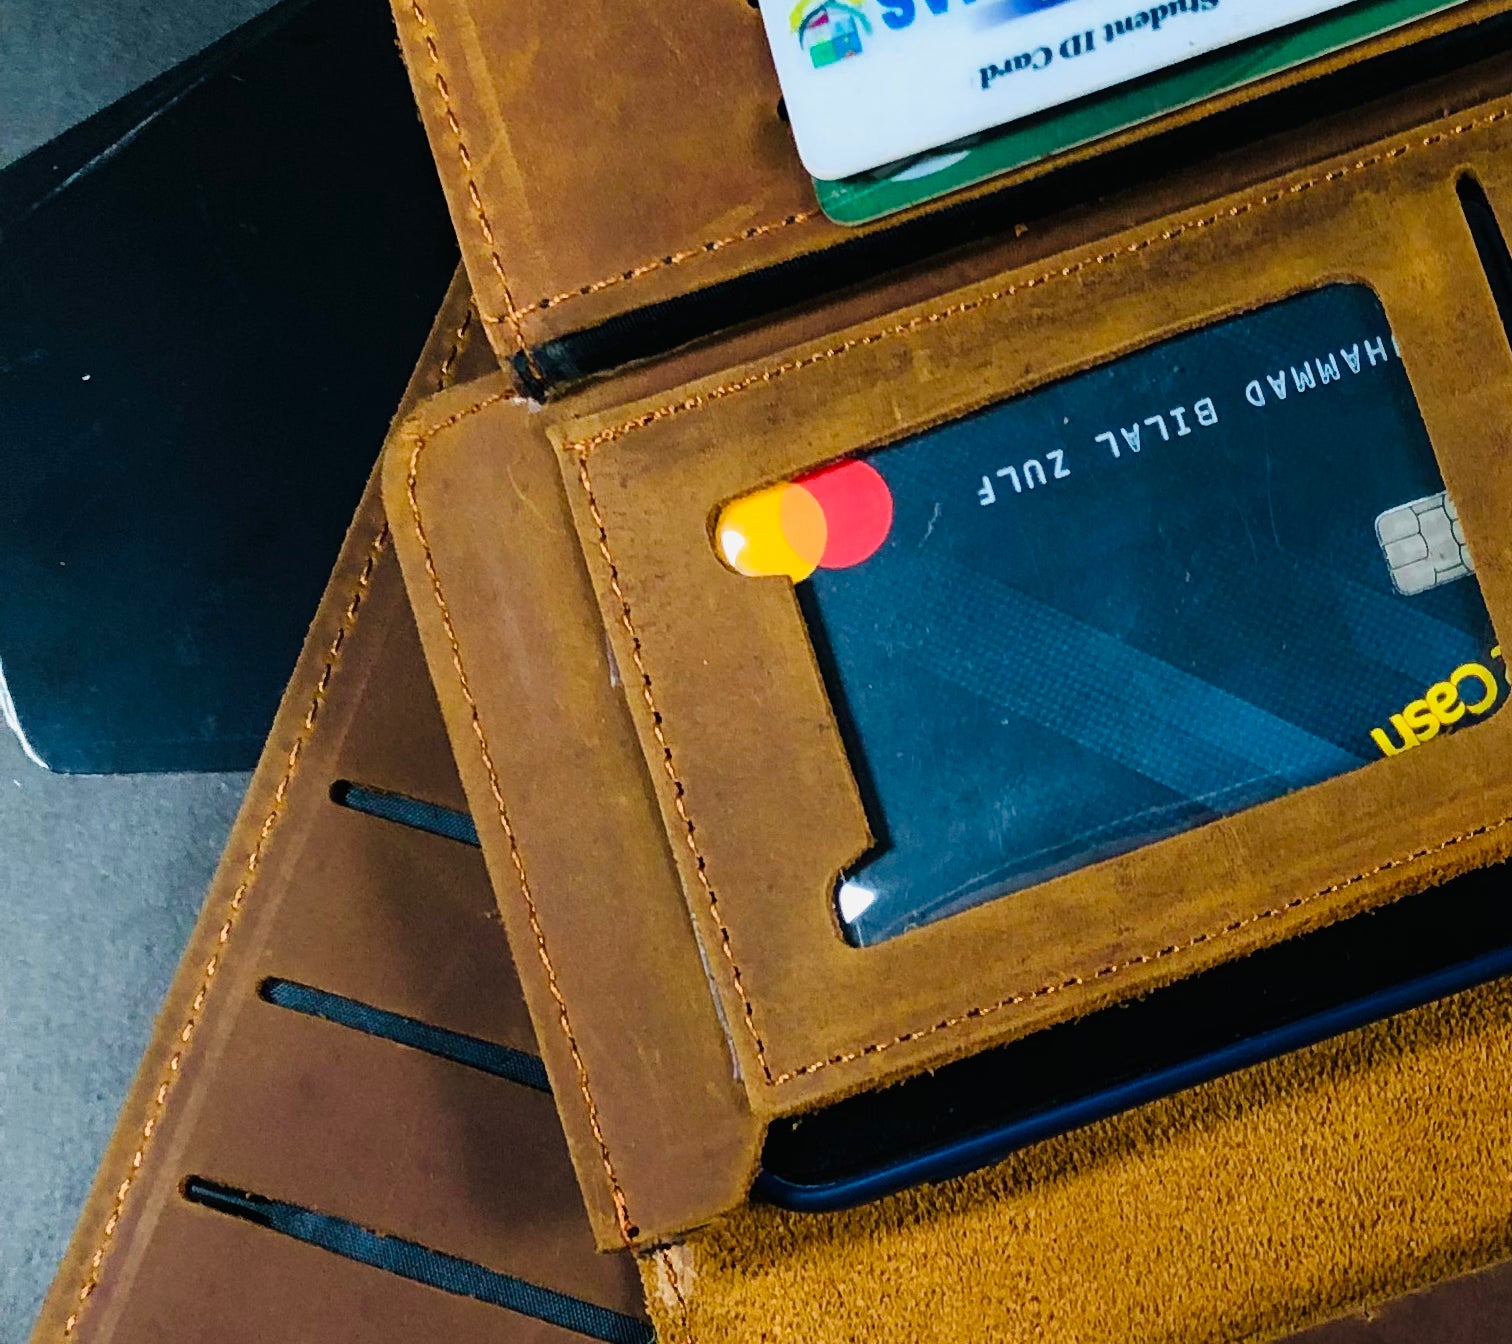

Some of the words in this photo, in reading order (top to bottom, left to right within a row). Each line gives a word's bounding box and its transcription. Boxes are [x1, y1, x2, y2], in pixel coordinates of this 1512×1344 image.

[979, 46, 1053, 90] Card
[1059, 29, 1094, 60] ID
[1245, 335, 1402, 407] HAMMAD
[1094, 397, 1219, 458] BILAL
[977, 449, 1071, 507] ZULF
